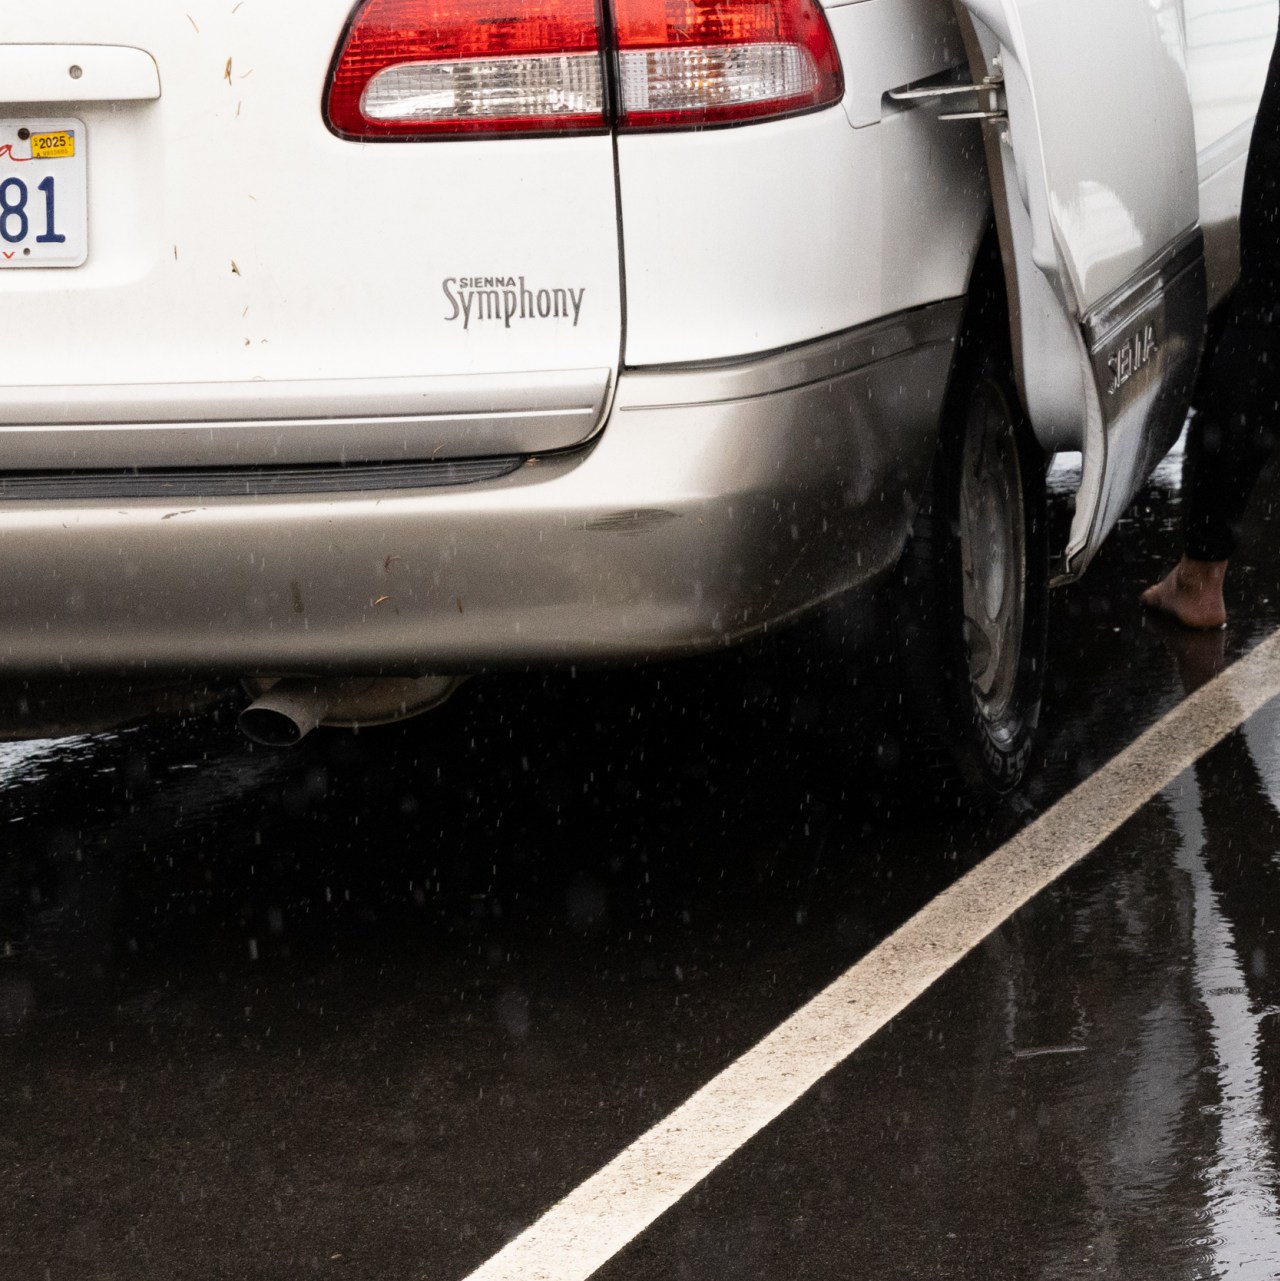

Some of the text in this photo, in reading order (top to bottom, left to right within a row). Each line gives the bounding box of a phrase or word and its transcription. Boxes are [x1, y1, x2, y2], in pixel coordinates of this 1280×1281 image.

[38, 136, 66, 149] 2025
[0, 176, 66, 243] 81
[458, 276, 517, 288] SIENNA
[442, 275, 586, 330] Symphony
